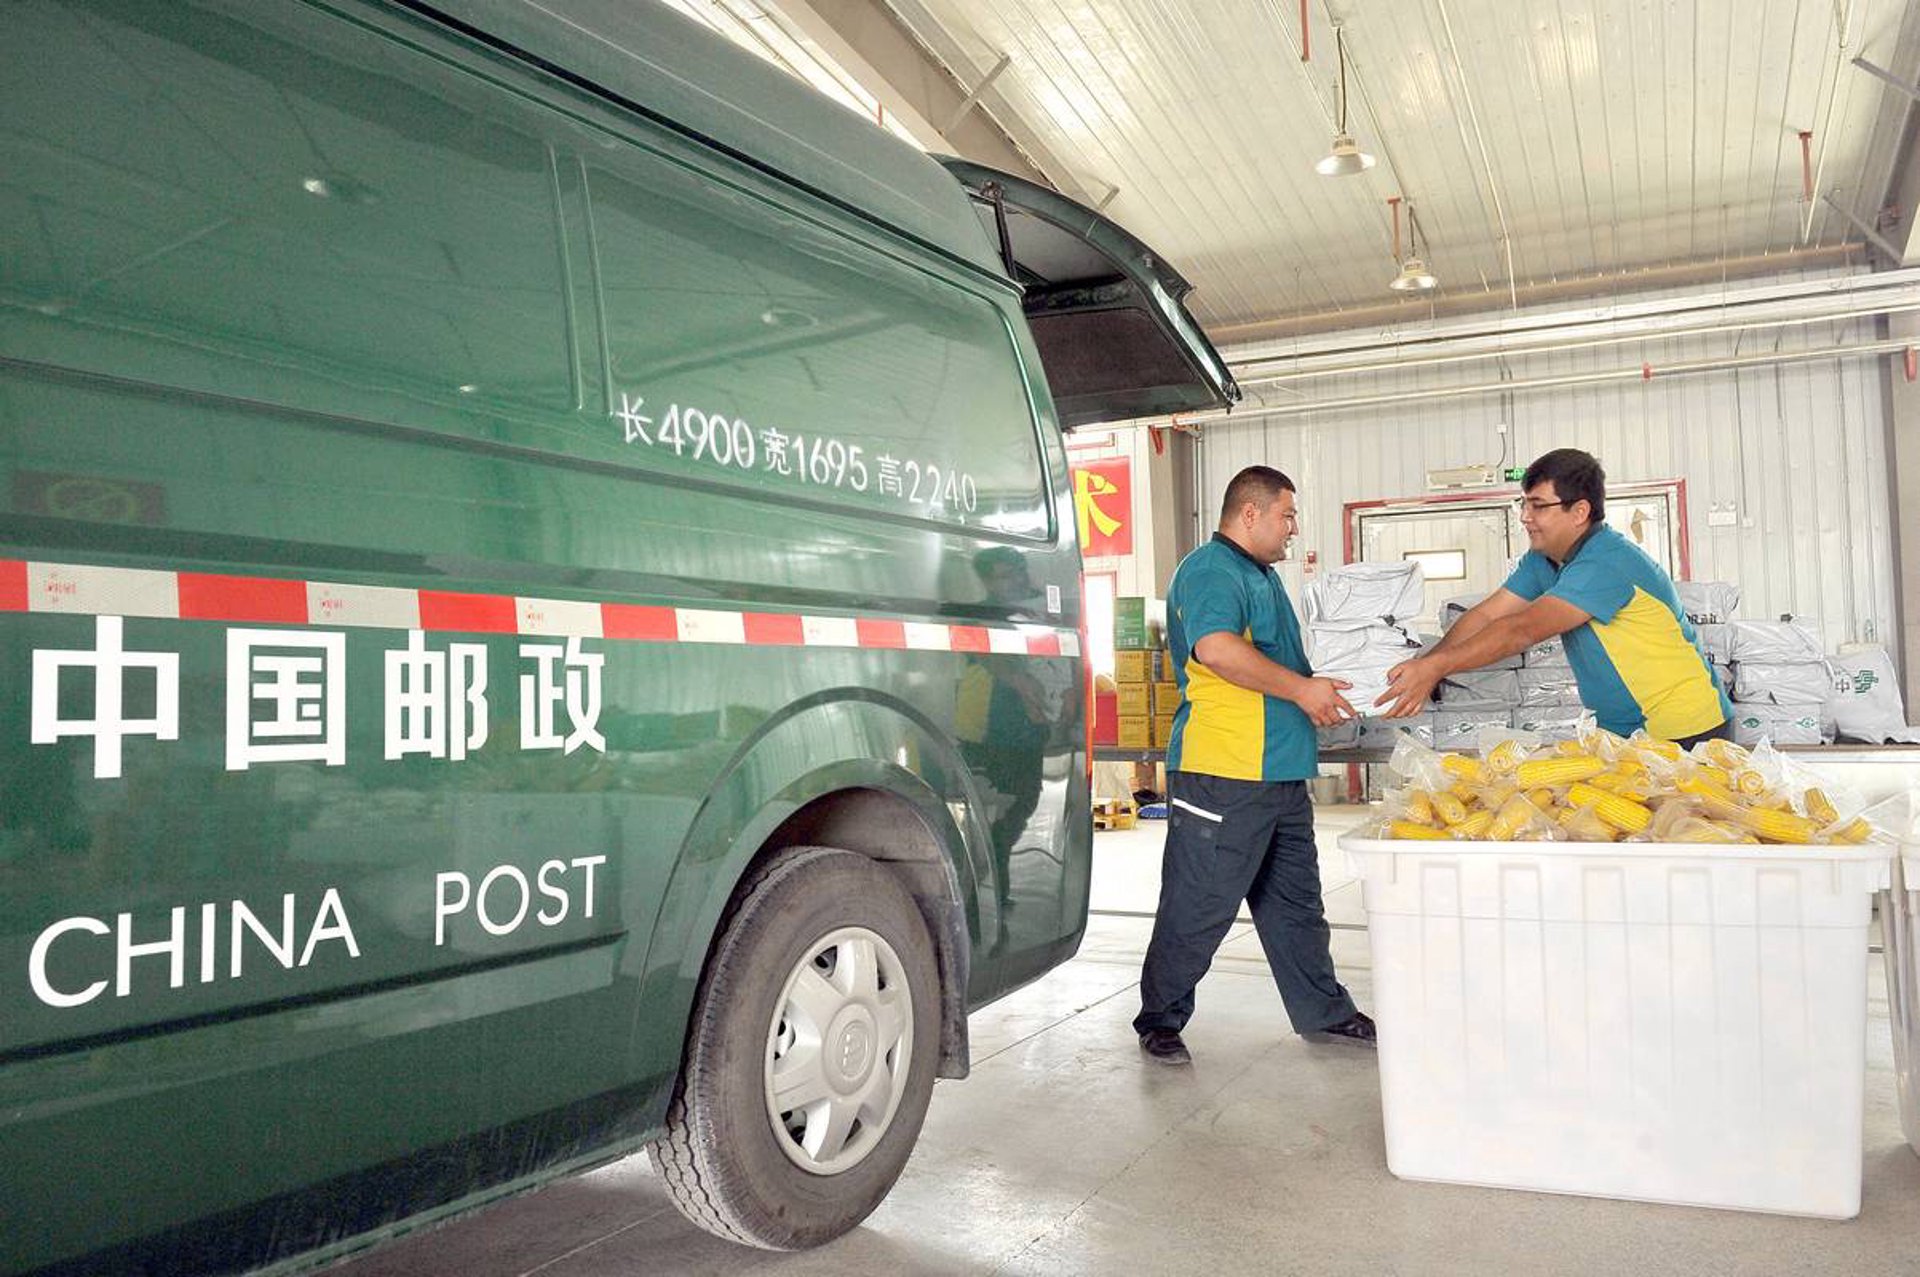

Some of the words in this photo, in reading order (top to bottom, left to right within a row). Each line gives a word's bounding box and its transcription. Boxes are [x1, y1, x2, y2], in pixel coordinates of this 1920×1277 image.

[31, 615, 606, 779] 中国邮政
[28, 888, 360, 1009] CHINA
[434, 855, 606, 946] POST
